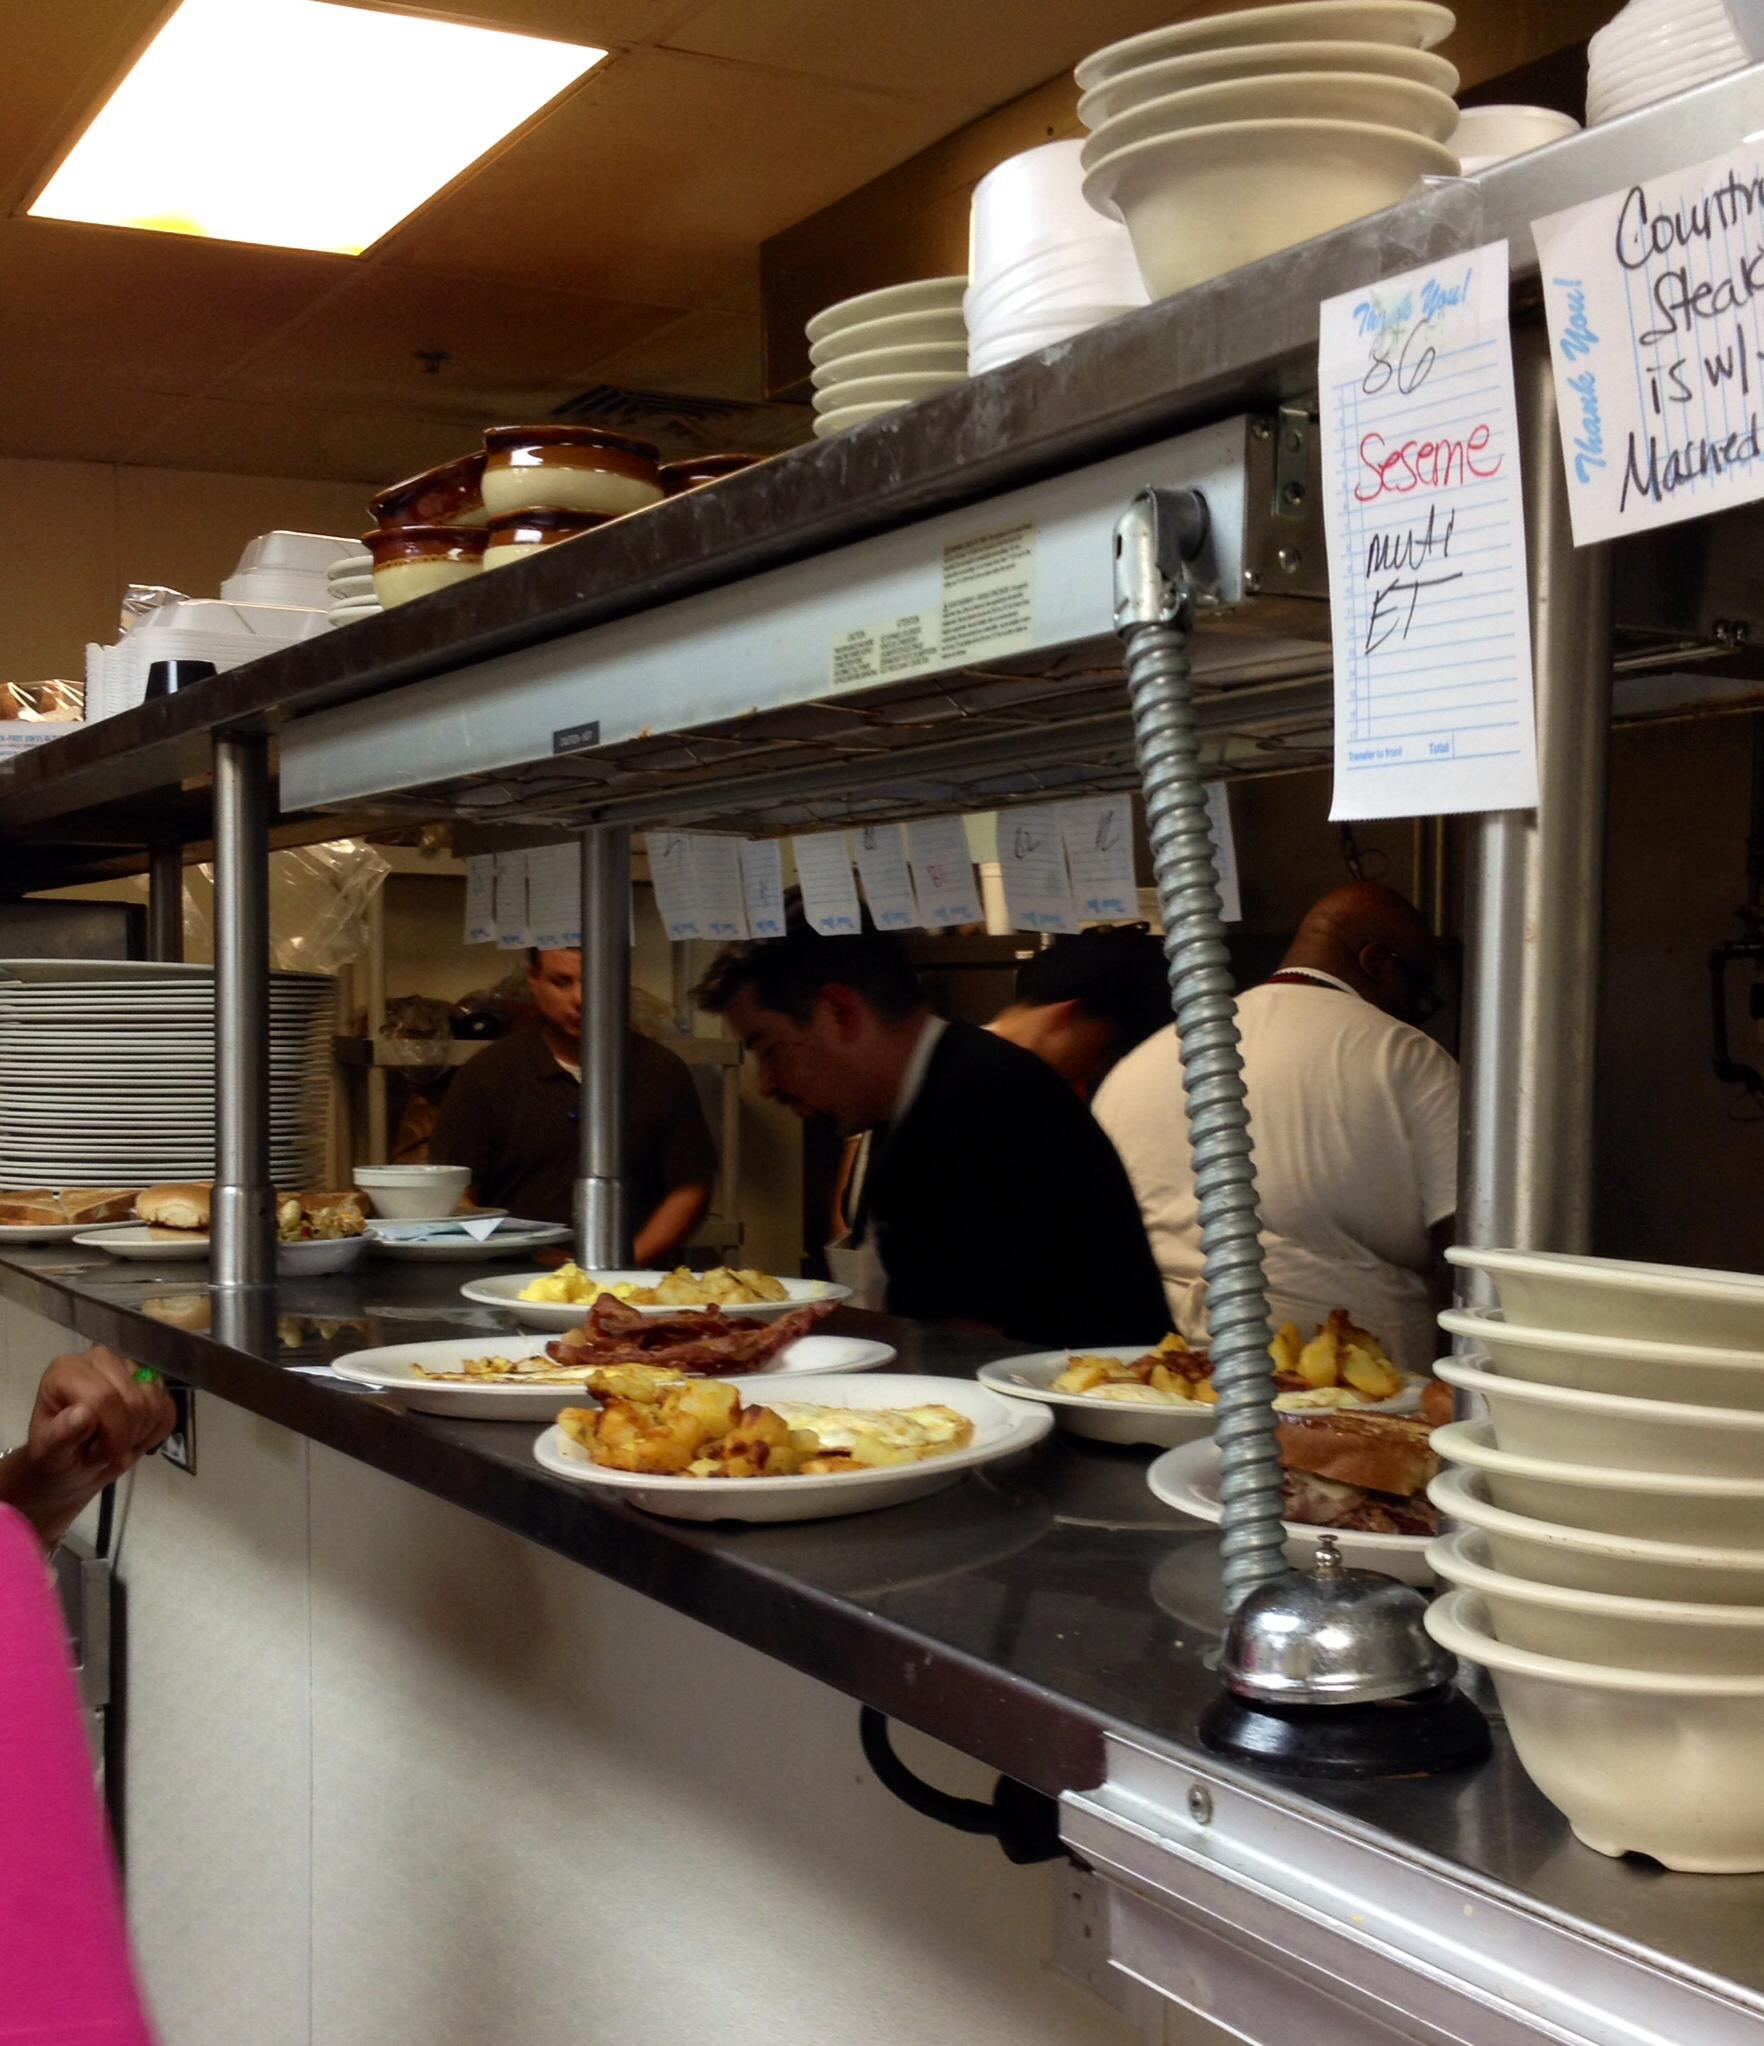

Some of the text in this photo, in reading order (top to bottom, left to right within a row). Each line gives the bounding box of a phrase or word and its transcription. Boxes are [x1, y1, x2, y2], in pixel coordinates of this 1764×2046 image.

[1420, 268, 1472, 322] You!
[1553, 277, 1606, 484] Thank You!
[1646, 358, 1693, 415] is
[1354, 423, 1503, 502] Seseme
